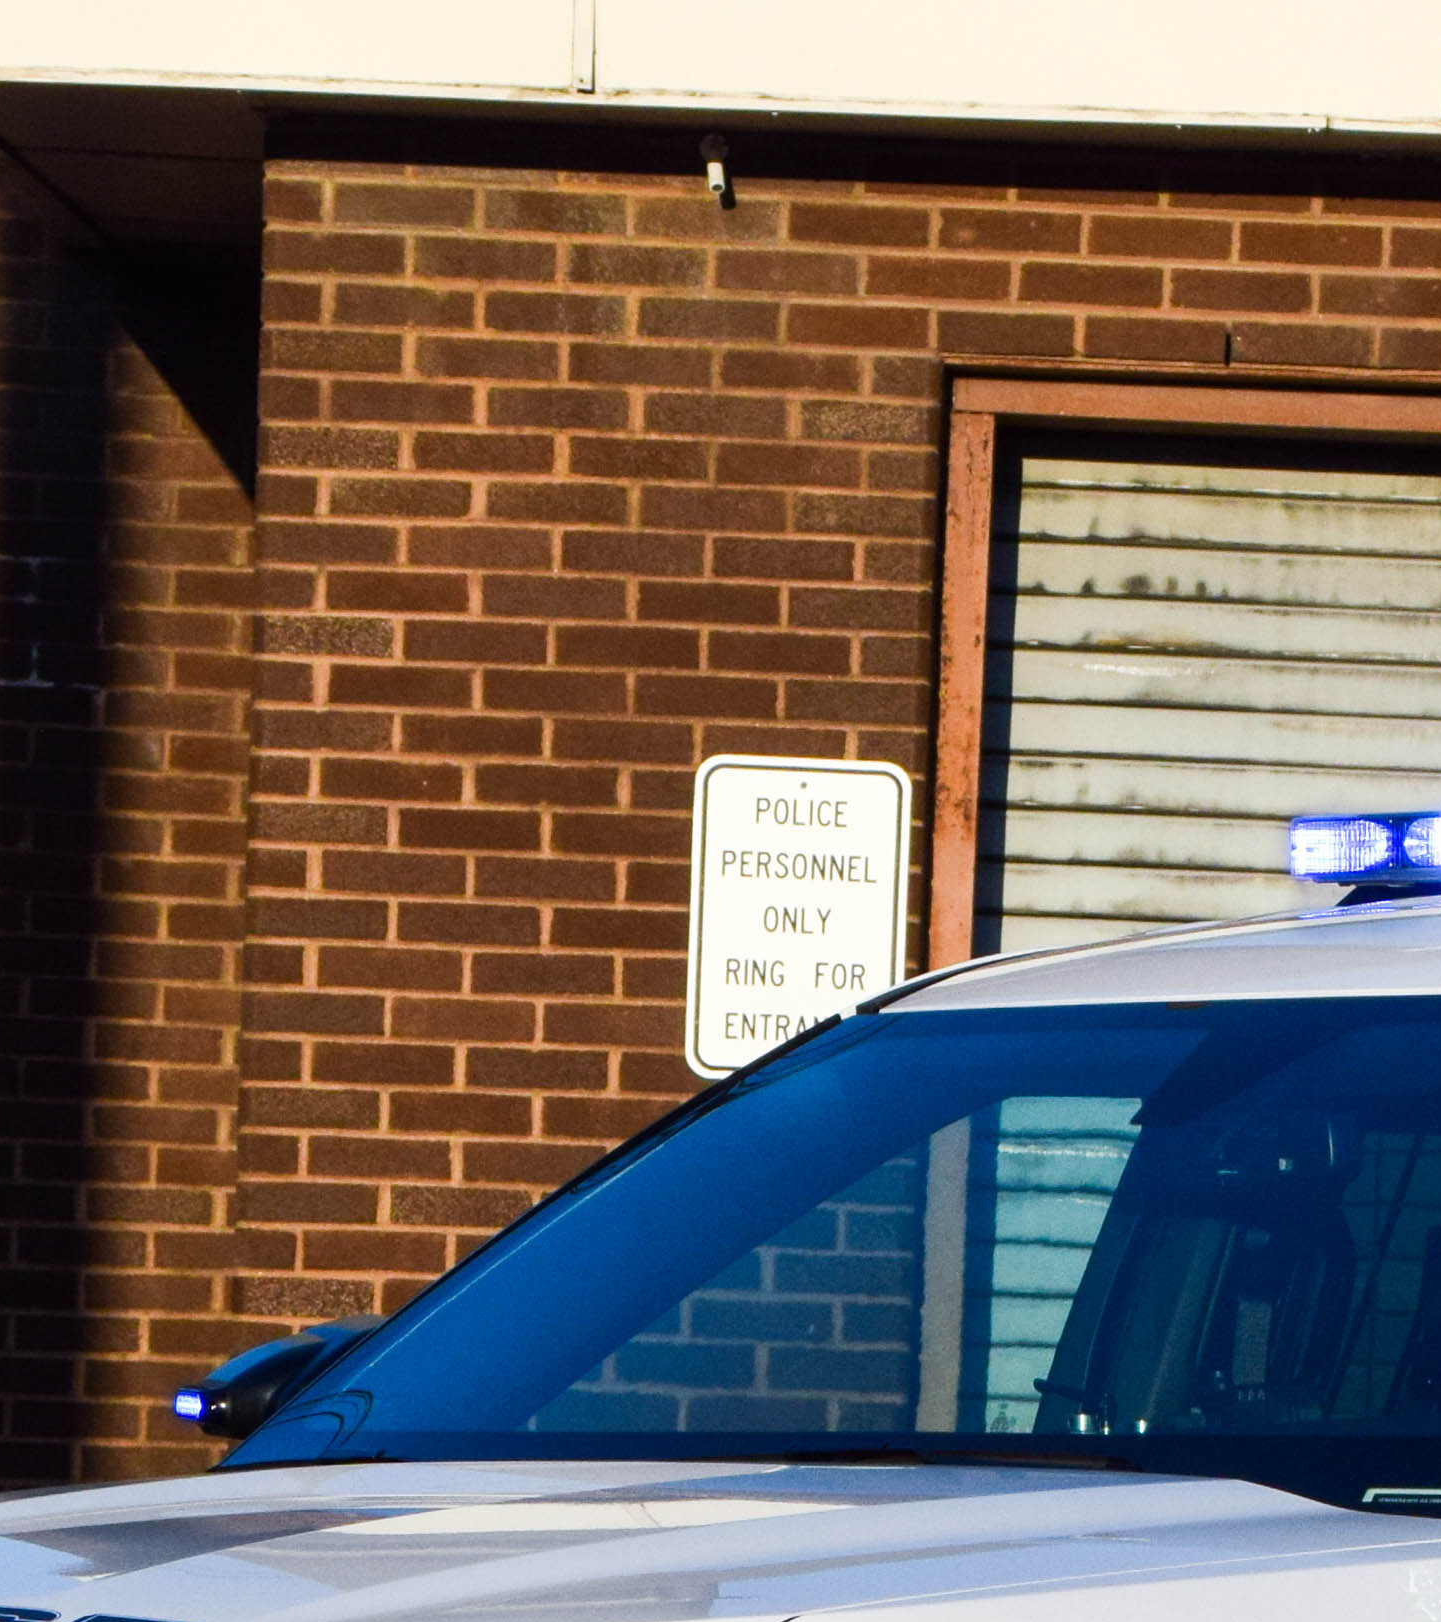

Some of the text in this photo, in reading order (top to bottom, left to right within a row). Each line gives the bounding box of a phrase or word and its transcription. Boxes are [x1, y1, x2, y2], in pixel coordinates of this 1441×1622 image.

[755, 797, 849, 828] POLICE
[720, 850, 878, 884] PERSONNEL
[762, 906, 832, 936] ONLY
[724, 958, 867, 992] RING FOR
[724, 1012, 830, 1041] ENTRA
